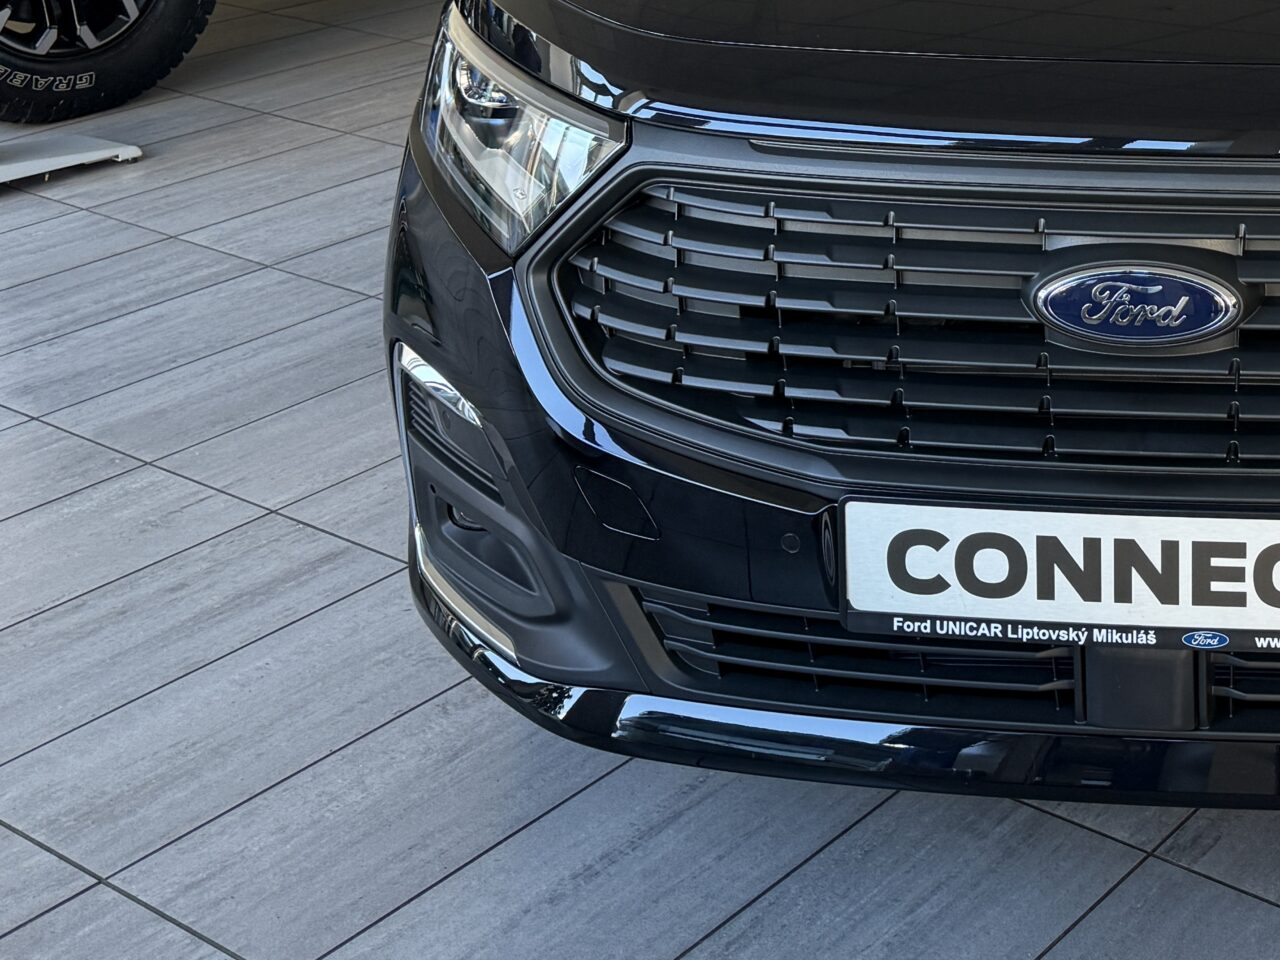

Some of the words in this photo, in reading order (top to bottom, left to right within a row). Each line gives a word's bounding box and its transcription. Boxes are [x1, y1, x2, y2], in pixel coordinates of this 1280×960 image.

[1080, 281, 1190, 327] Ford
[893, 617, 931, 634] Ford
[936, 620, 1003, 638] UNICAR
[1007, 626, 1088, 645] Liptovský
[1093, 628, 1157, 645] Mikuláš
